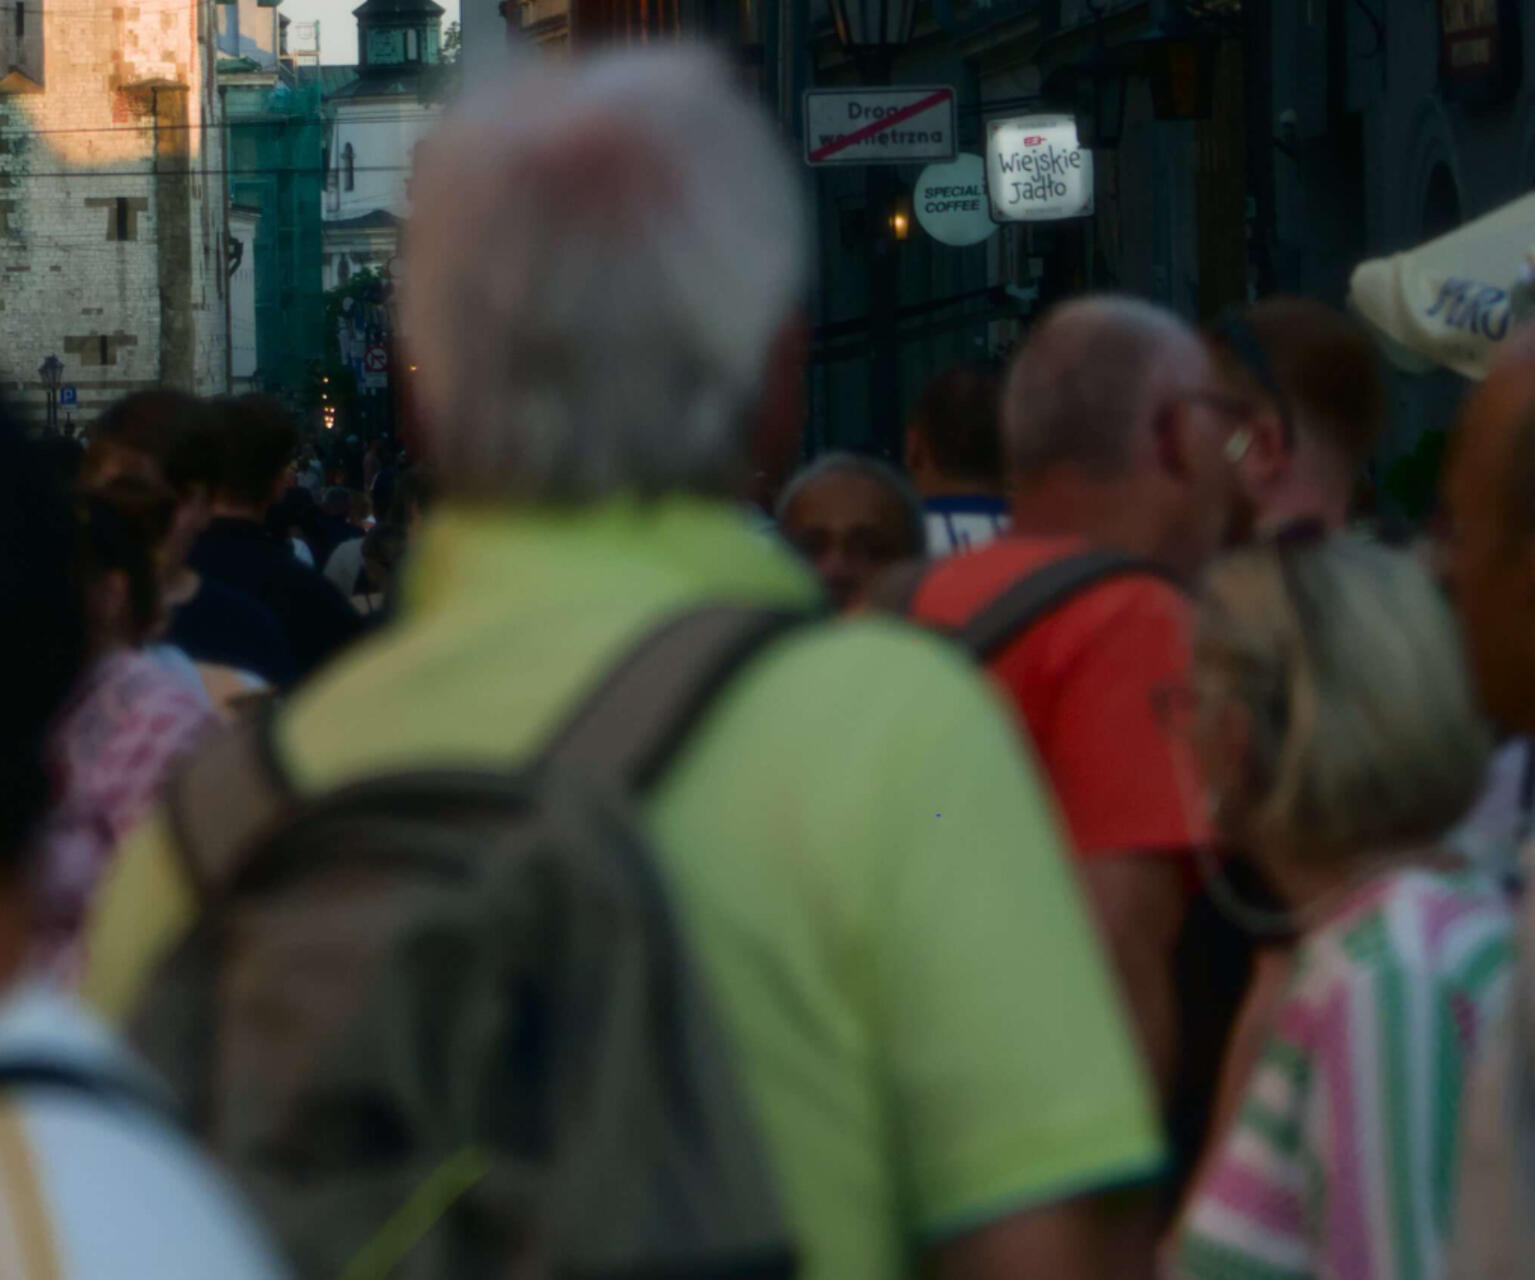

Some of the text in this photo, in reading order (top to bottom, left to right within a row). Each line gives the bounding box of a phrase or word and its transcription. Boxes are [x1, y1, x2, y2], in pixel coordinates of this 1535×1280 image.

[998, 144, 1081, 183] Wiejskie
[1008, 174, 1068, 205] Jadło
[925, 199, 980, 214] COFFEE
